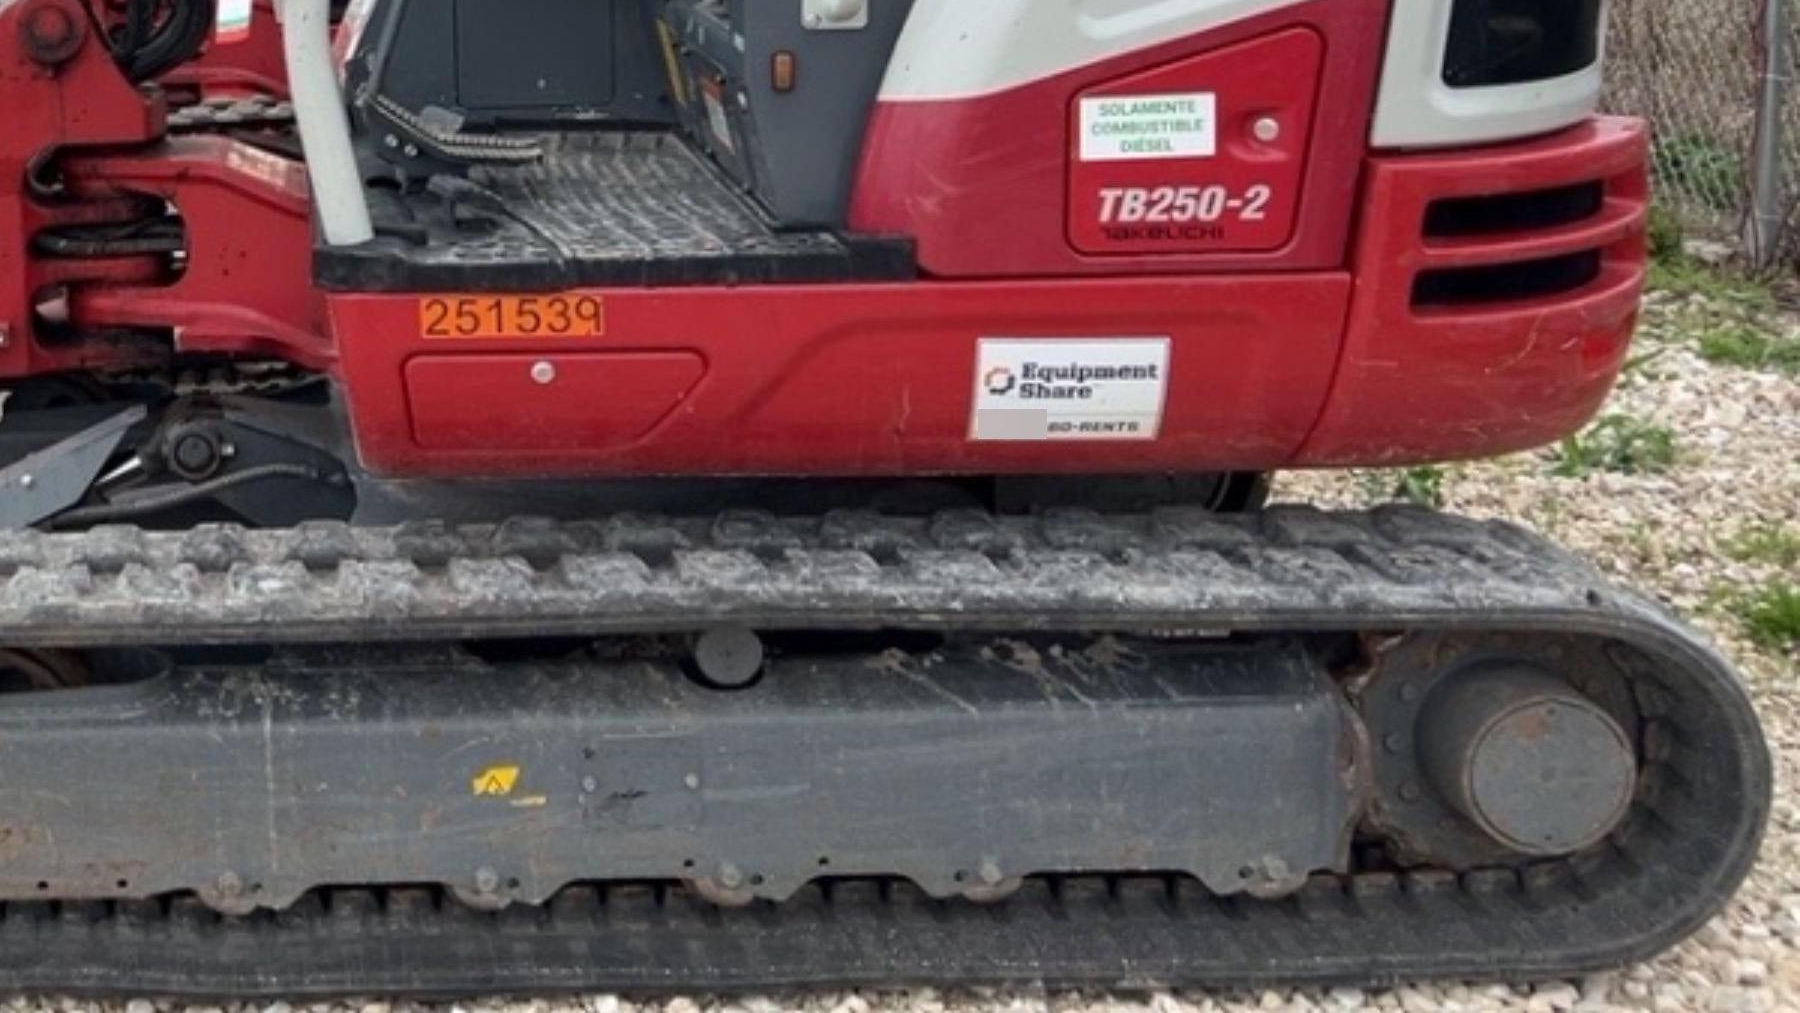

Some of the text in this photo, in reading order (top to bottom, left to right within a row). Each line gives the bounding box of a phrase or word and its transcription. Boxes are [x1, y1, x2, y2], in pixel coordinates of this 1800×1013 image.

[1098, 100, 1197, 117] SOLAMENTE
[1091, 118, 1204, 136] COMBUSTIBLE
[1097, 184, 1271, 222] TB250-2
[424, 295, 602, 336] 251539
[1021, 361, 1160, 384] Equipment
[1018, 383, 1093, 399] Share
